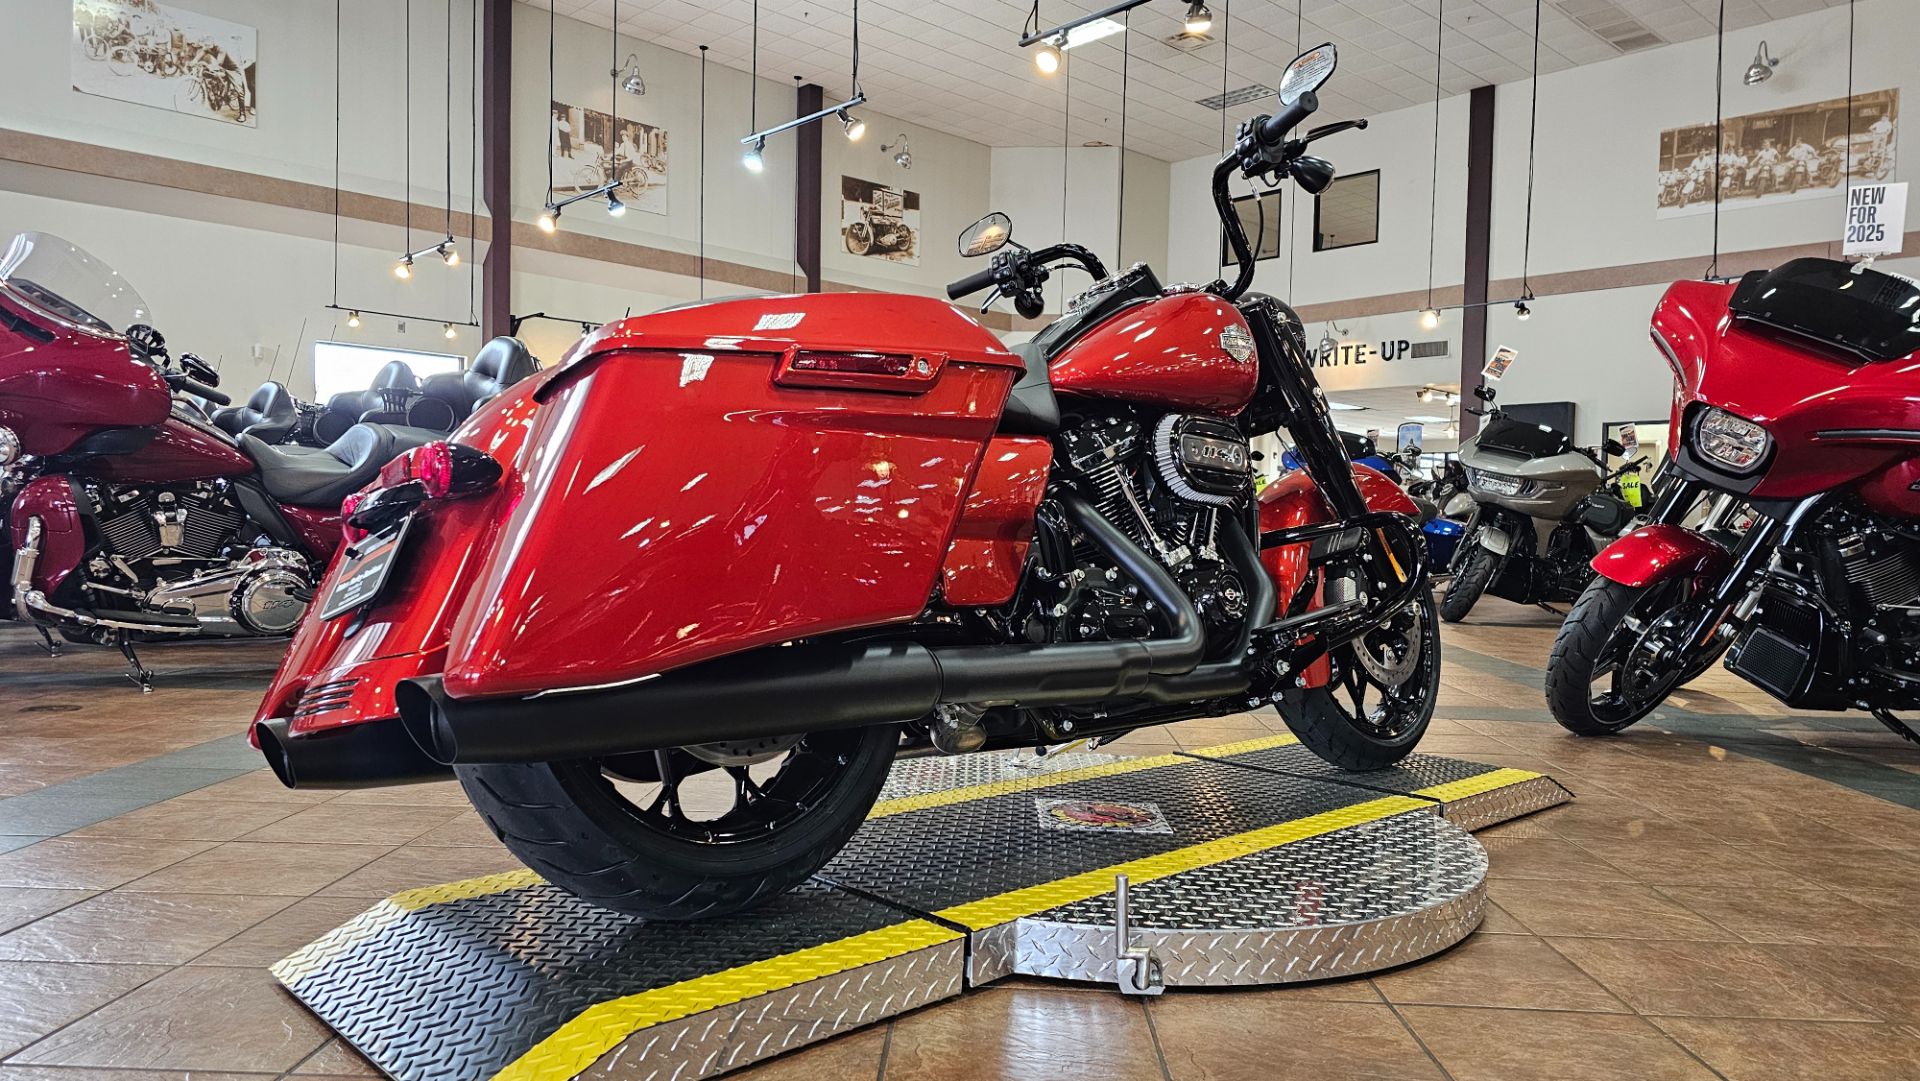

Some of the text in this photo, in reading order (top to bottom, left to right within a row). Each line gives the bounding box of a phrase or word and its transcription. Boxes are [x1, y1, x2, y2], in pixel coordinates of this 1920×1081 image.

[1850, 186, 1886, 206] NEW
[1848, 206, 1877, 224] FOR
[1846, 223, 1885, 243] 2025
[1622, 481, 1639, 489] SALE
